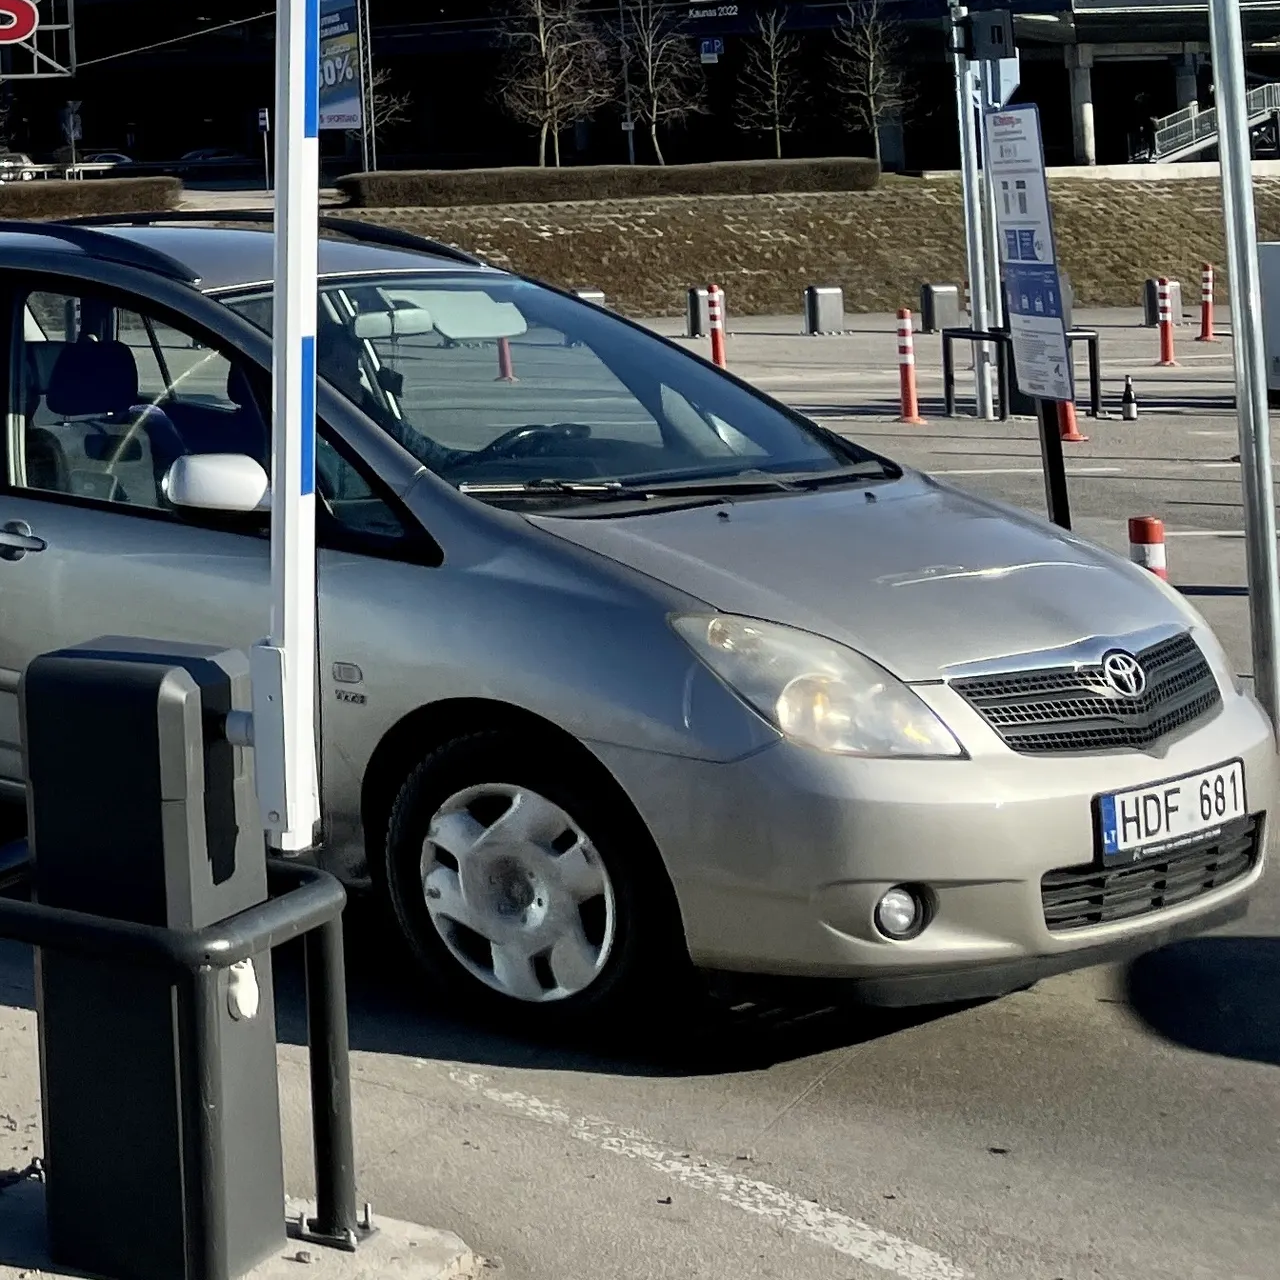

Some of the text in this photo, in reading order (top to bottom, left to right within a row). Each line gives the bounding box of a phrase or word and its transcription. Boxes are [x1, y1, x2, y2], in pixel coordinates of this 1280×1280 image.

[688, 5, 739, 18] Kaunas 2022
[1120, 769, 1239, 843] HDF 681
[1103, 829, 1117, 845] LT
